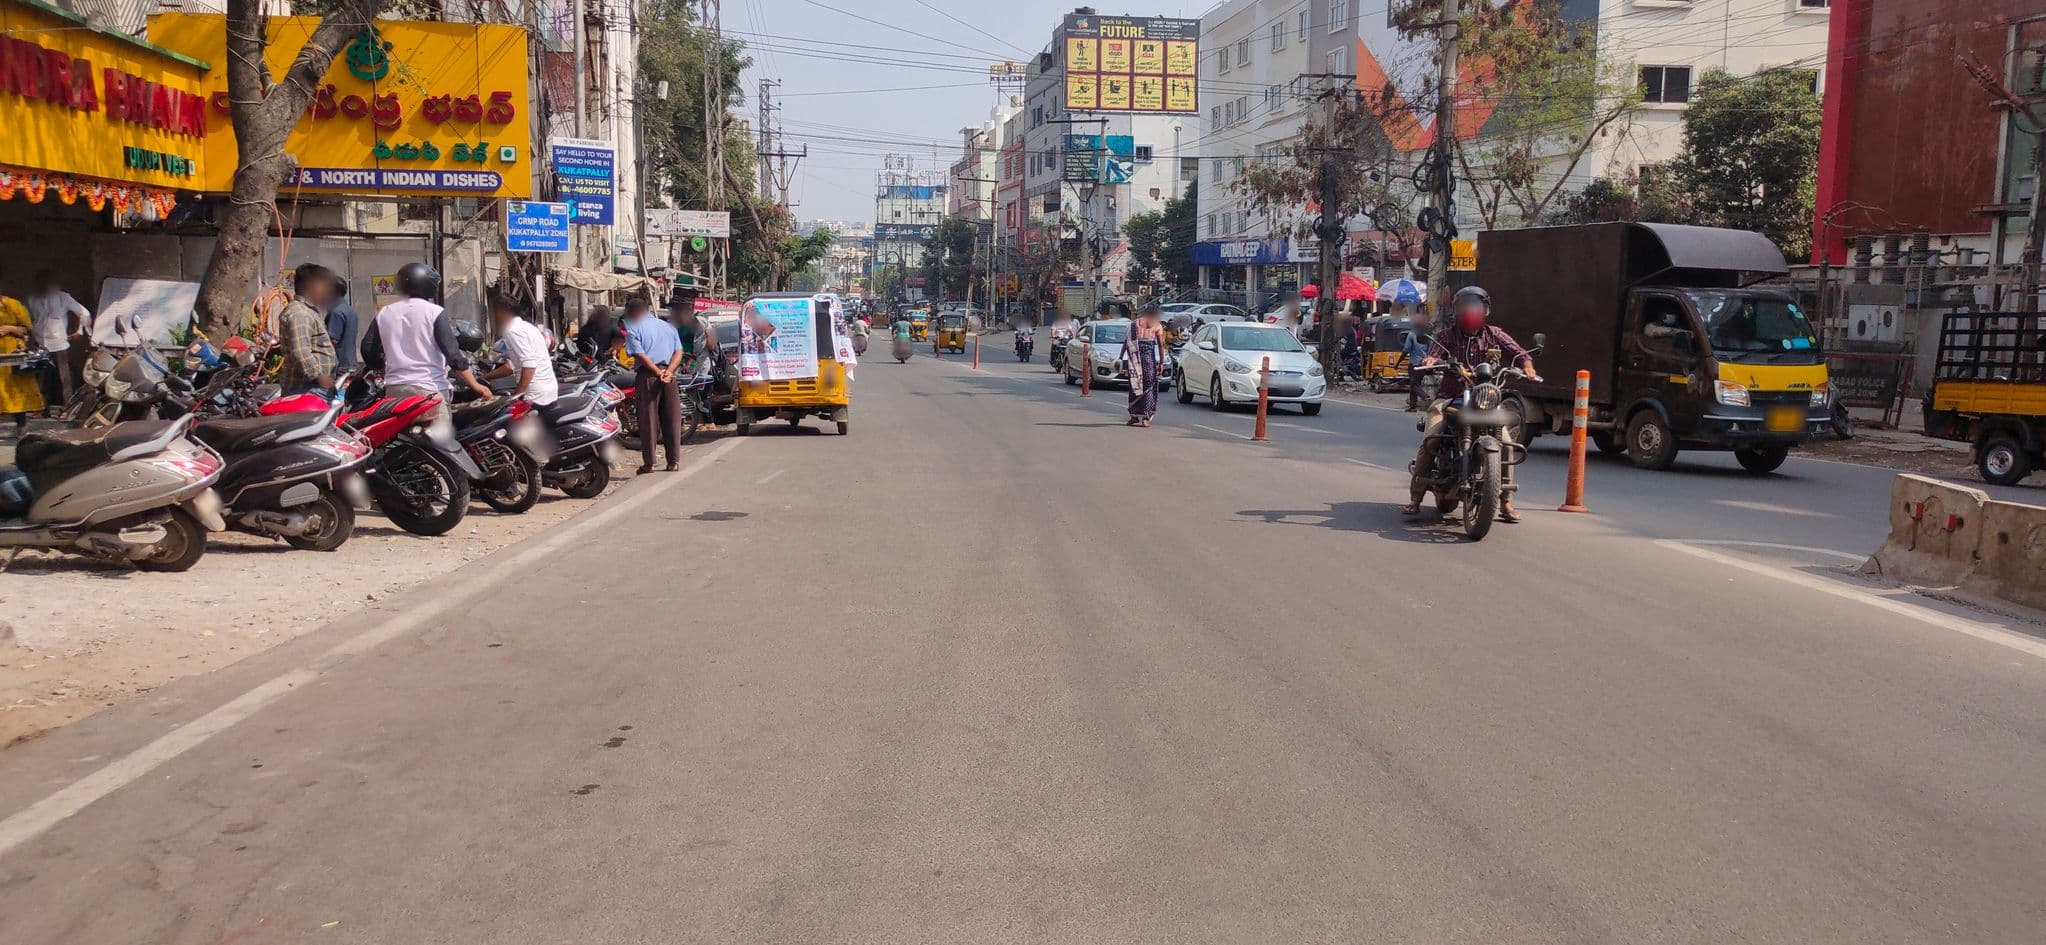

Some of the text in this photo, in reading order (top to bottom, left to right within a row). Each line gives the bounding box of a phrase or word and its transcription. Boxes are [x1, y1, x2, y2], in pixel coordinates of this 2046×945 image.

[1100, 26, 1145, 38] FUTURE
[104, 68, 207, 138] BHAVAN
[558, 157, 583, 165] SECOND
[558, 166, 610, 177] KUKATPALLY
[302, 170, 314, 184] &
[321, 171, 375, 185] NORTH
[382, 172, 436, 186] INDIAN
[443, 173, 498, 187] DISHES
[578, 209, 600, 219] living
[518, 217, 559, 226] CRMP ROAD
[510, 228, 568, 237] KUKATPALLY ZONE
